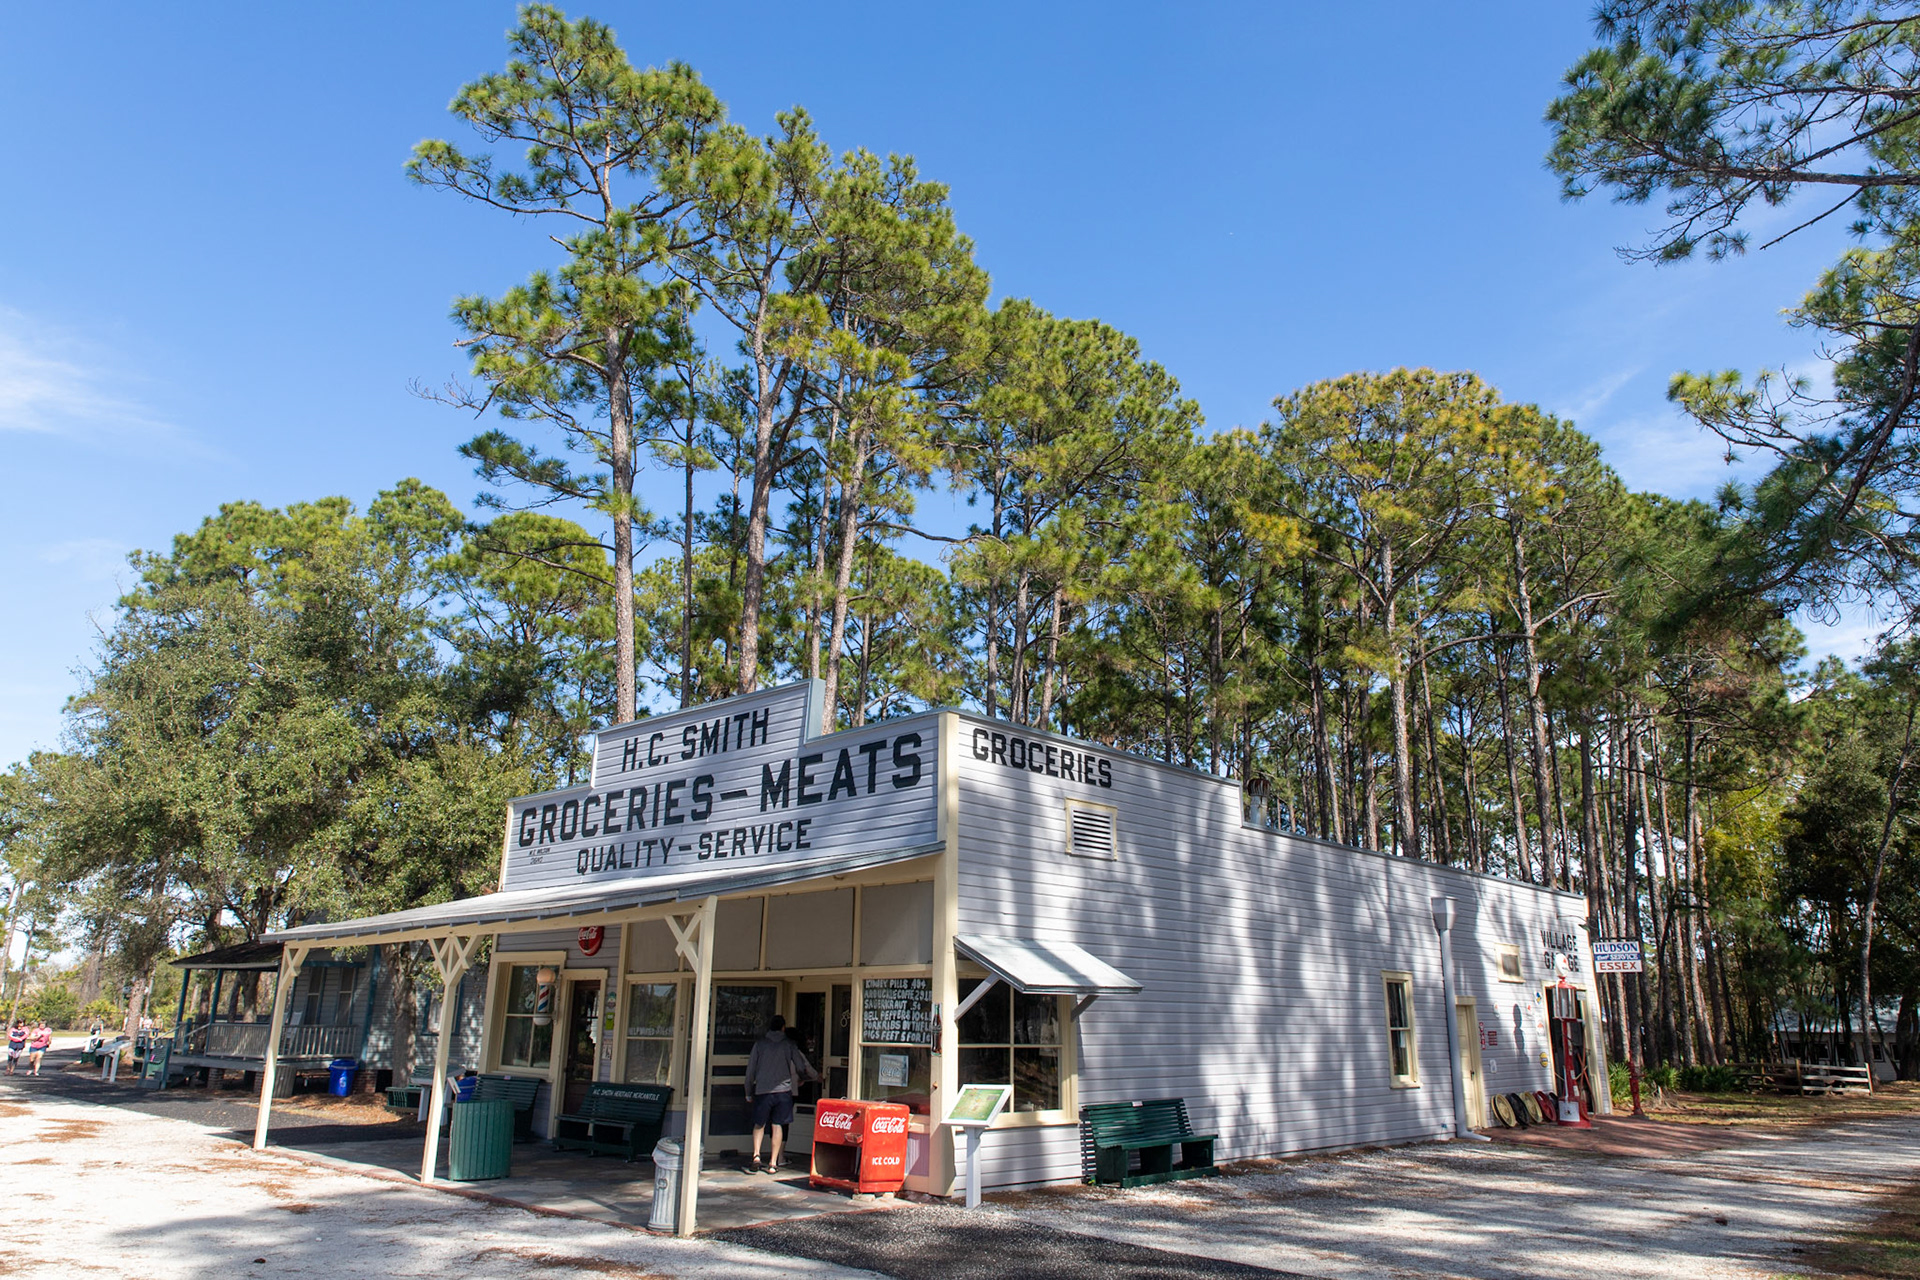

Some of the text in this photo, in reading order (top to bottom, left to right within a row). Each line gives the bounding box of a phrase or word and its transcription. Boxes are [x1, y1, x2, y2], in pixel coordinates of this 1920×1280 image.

[681, 708, 769, 760] SMITH
[973, 728, 1112, 788] GROCERIES
[1540, 930, 1578, 952] VILLAGE
[1595, 943, 1638, 953] HUDSON
[1544, 951, 1580, 972] GAGE
[1600, 962, 1637, 970] ESSEX
[890, 979, 908, 989] PILLS
[864, 999, 907, 1010] SAUERKRAUT
[864, 1010, 878, 1020] BELL
[880, 1009, 911, 1020] PEPPERS
[864, 1020, 880, 1030] PORK
[881, 1020, 900, 1030] RIBS
[863, 1030, 879, 1040] PIGS
[881, 1030, 900, 1040] FEET
[907, 1031, 920, 1042] FOR
[820, 1111, 853, 1130] Coca-Cola
[871, 1116, 906, 1133] Coca-Cola
[872, 1156, 900, 1165] ICE COLD
